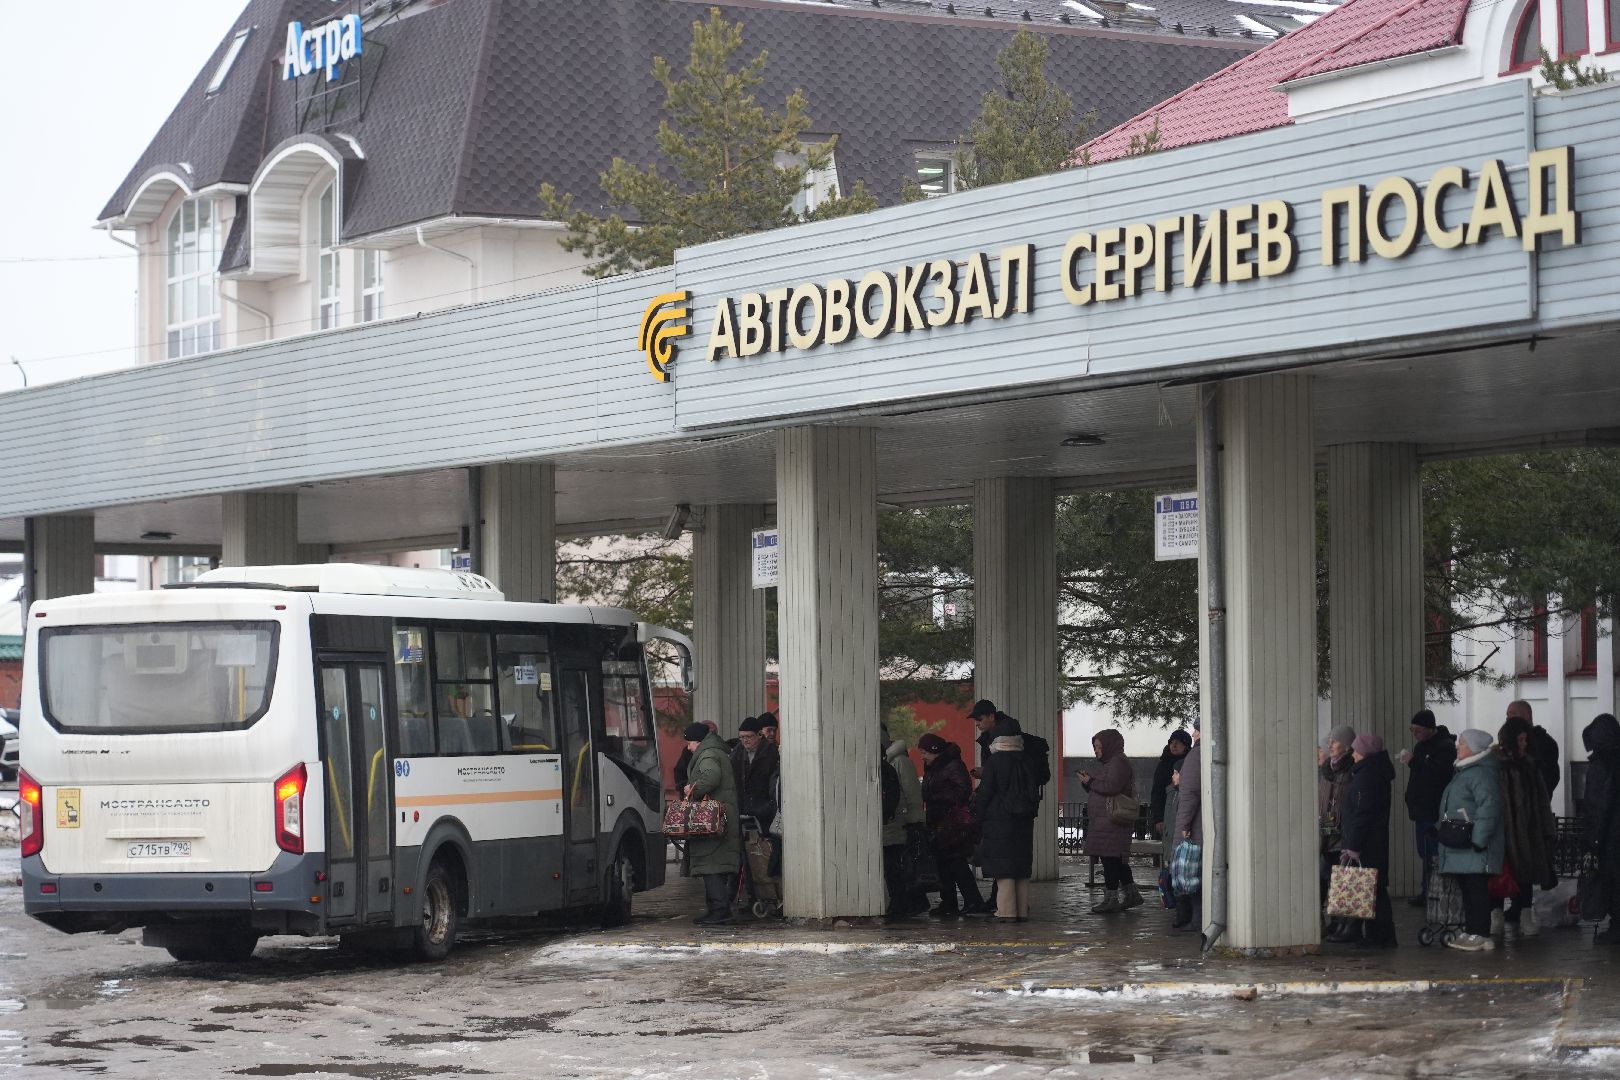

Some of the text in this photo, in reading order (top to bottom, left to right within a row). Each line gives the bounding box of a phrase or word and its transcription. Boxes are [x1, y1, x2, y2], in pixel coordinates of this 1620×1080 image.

[283, 14, 361, 82] Астра
[706, 145, 1582, 362] АВТОВОКЗАЛ СЕРГИЕВ ПОСАД
[100, 799, 210, 809] МОСТРАНСАВТО
